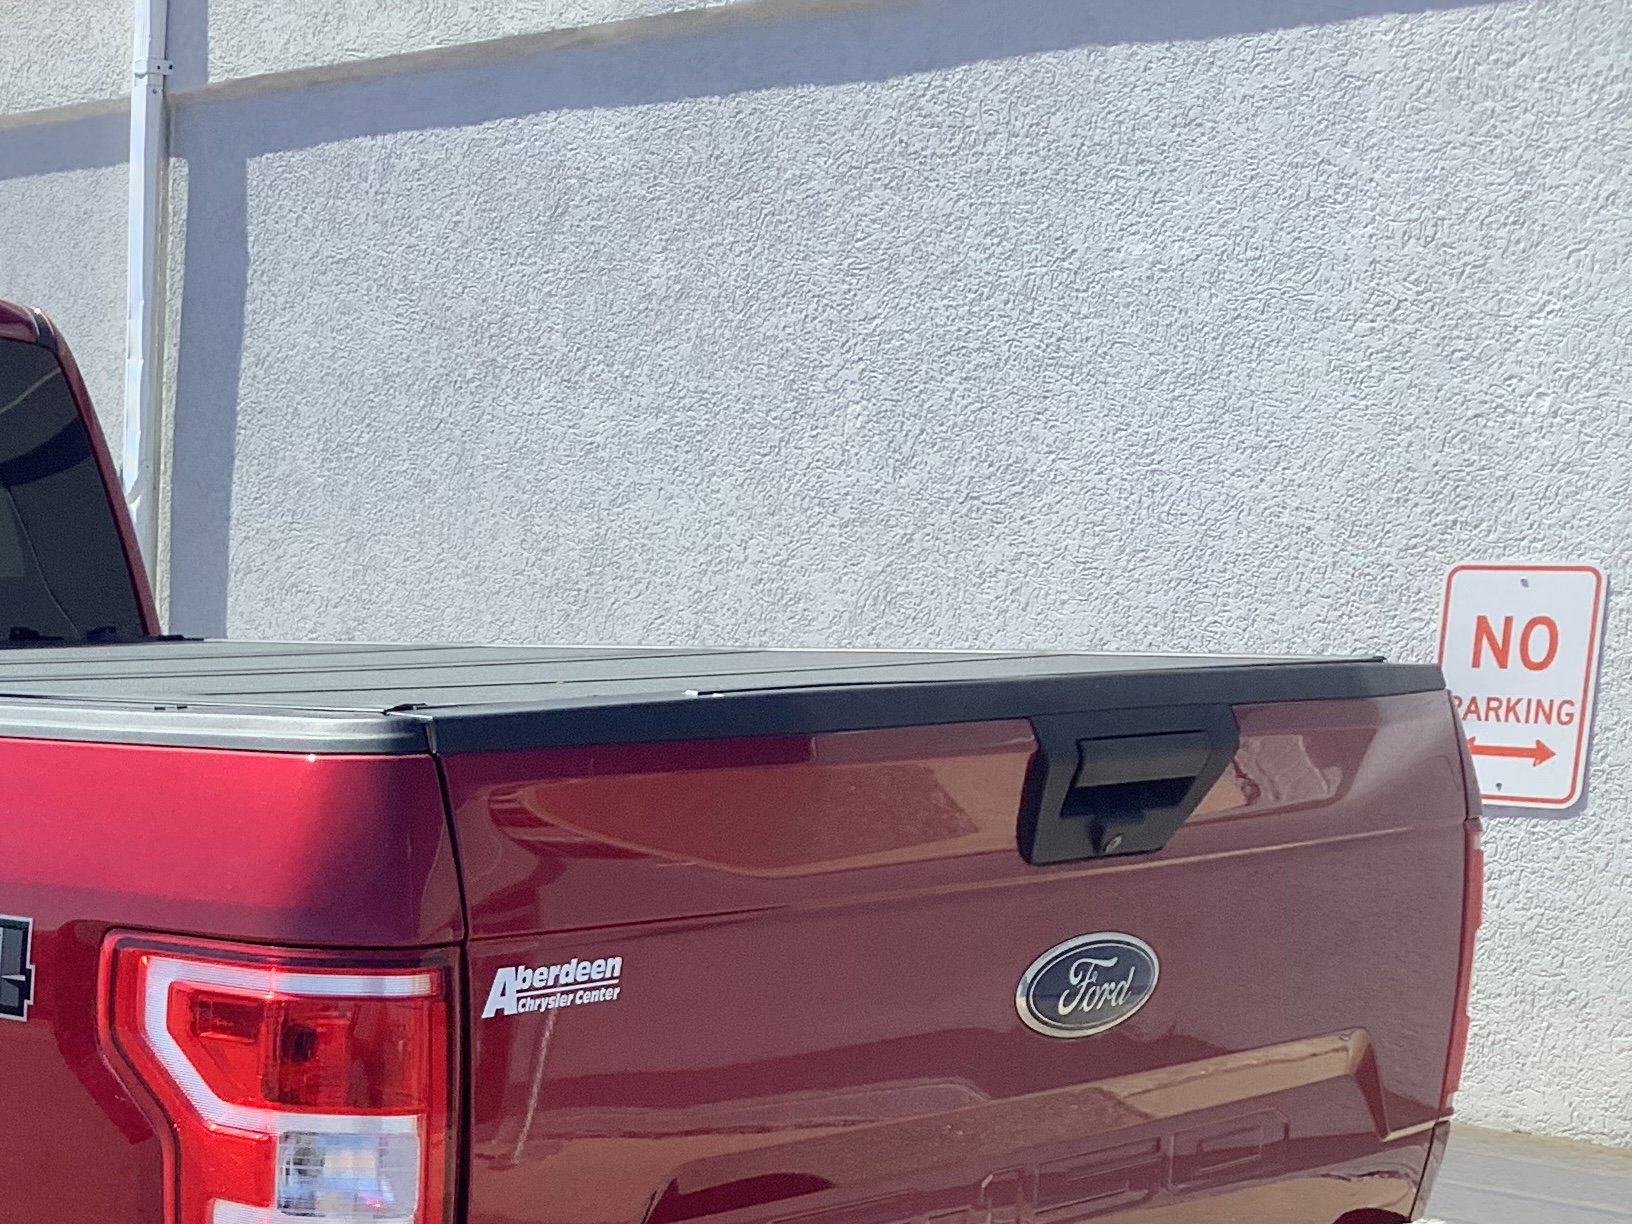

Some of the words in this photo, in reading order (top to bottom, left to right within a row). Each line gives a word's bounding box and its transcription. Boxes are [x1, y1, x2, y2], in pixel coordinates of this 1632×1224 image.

[1471, 615, 1559, 671] NO
[481, 957, 623, 1019] Aberdeen
[518, 993, 574, 1012] Chrysler
[576, 987, 620, 1005] Center
[1058, 956, 1135, 1016] Ford
